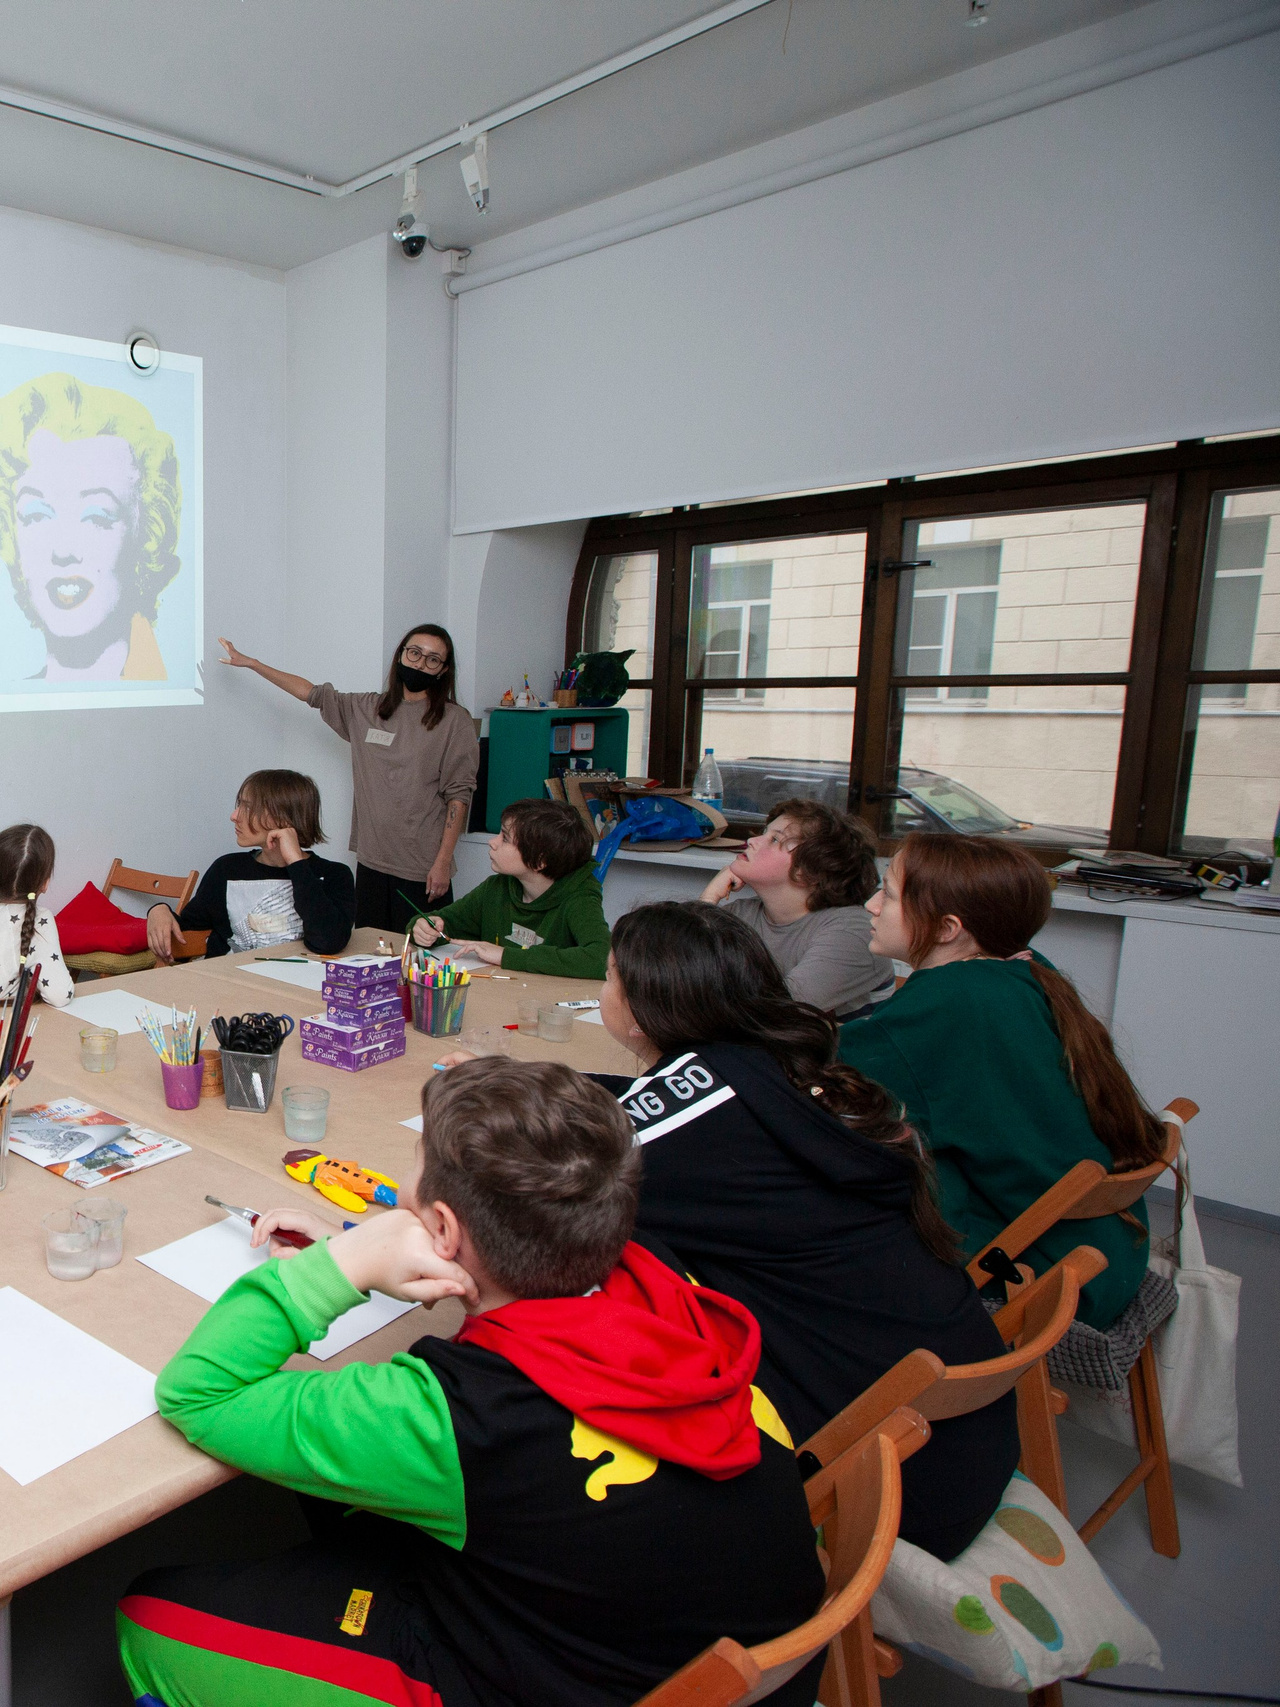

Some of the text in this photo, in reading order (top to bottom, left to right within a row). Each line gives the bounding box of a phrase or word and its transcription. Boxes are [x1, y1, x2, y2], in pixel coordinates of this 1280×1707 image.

[312, 1027, 333, 1041] Paints
[315, 1047, 337, 1061] Paints
[664, 1065, 714, 1100] GO
